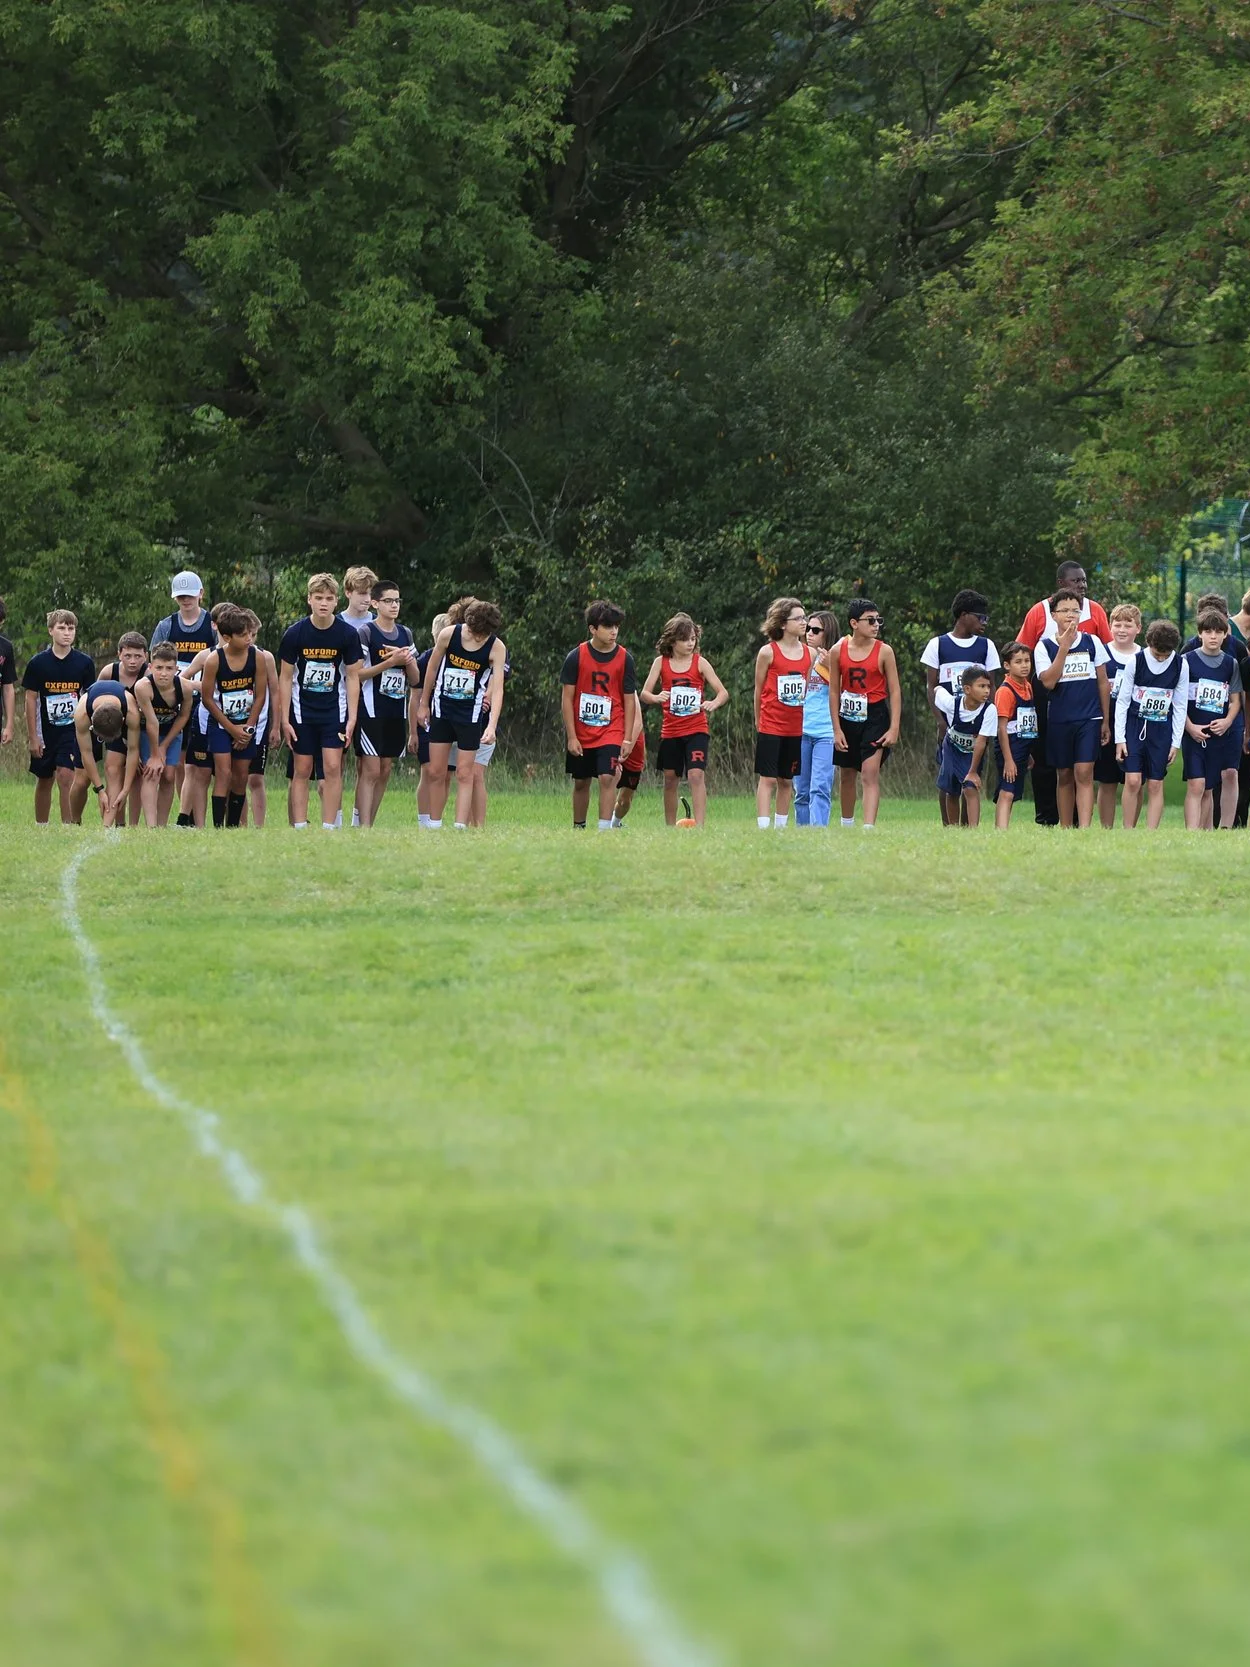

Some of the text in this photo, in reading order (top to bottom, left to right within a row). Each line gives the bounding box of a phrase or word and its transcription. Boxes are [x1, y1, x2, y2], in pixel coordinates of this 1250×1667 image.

[303, 648, 337, 656] OXFORD
[449, 653, 481, 670] OXFORD
[1065, 662, 1088, 673] 2257
[311, 669, 331, 681] 739
[449, 675, 469, 688] 717
[849, 667, 867, 689] R
[387, 676, 403, 689] 729
[591, 671, 611, 693] R
[783, 683, 803, 694] 605
[676, 694, 696, 706] 602
[1203, 687, 1221, 701] 684
[53, 701, 74, 714] 725
[230, 698, 247, 710] 741
[585, 702, 604, 715] 601
[844, 698, 862, 712] 603
[1146, 699, 1165, 710] 686
[953, 734, 973, 747] 689
[691, 750, 704, 762] R
